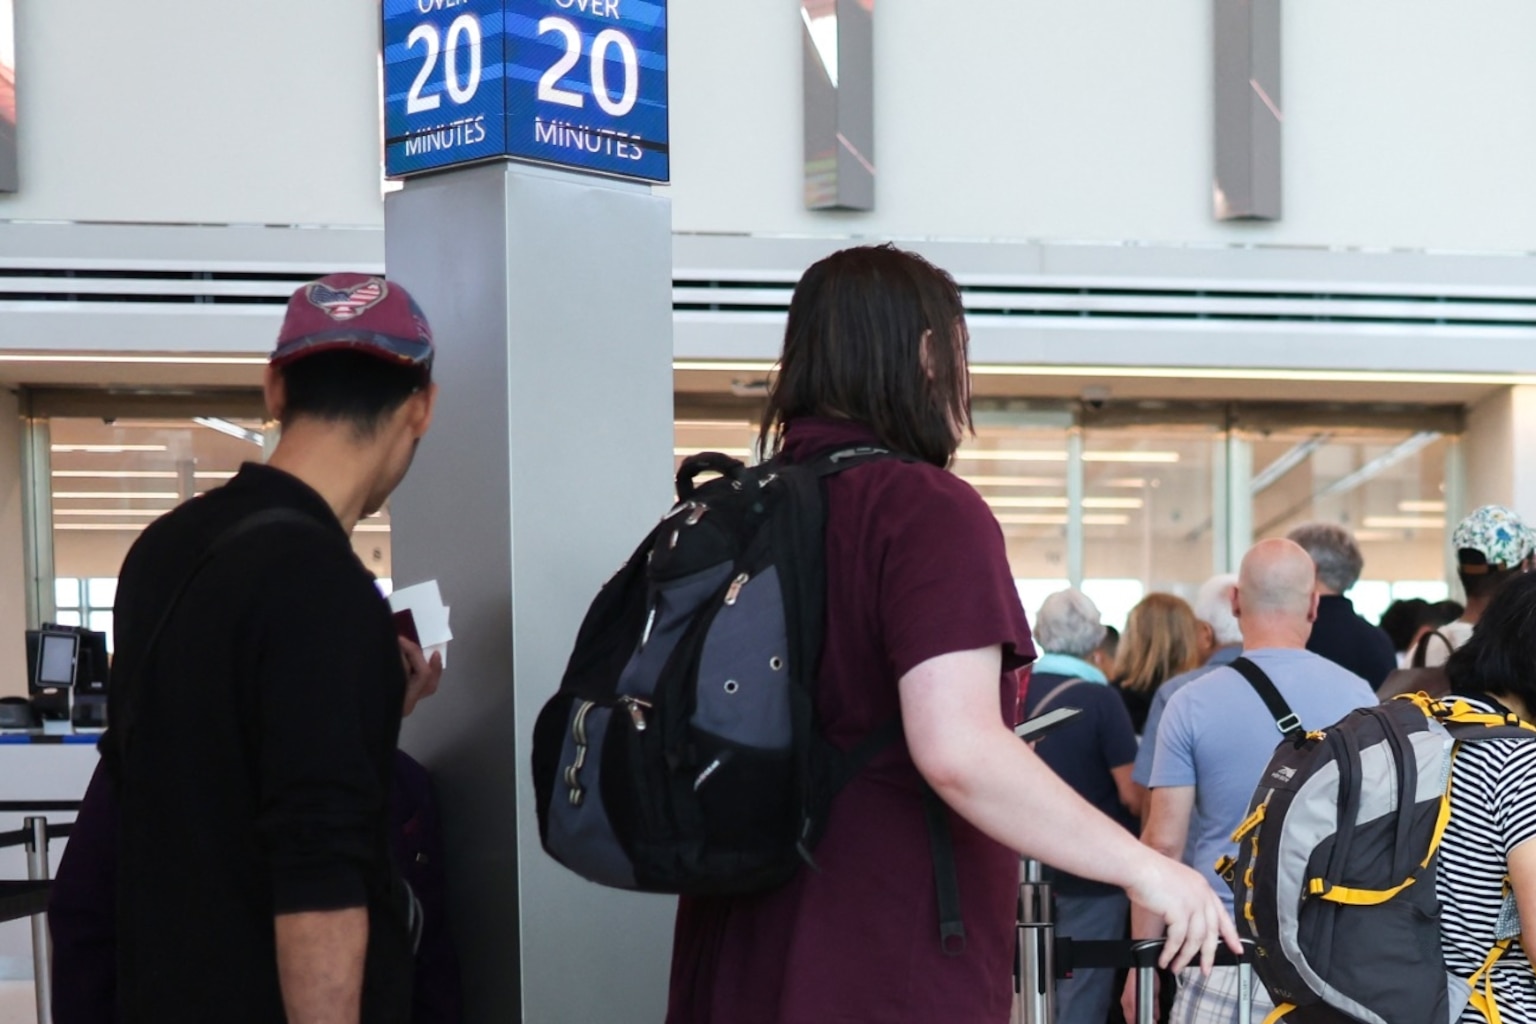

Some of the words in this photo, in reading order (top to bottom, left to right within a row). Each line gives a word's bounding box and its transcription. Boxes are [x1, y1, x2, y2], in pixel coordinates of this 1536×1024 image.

[407, 14, 482, 115] 20
[537, 16, 639, 117] 20
[404, 116, 486, 157] MINUTES
[535, 116, 643, 160] MINUTES
